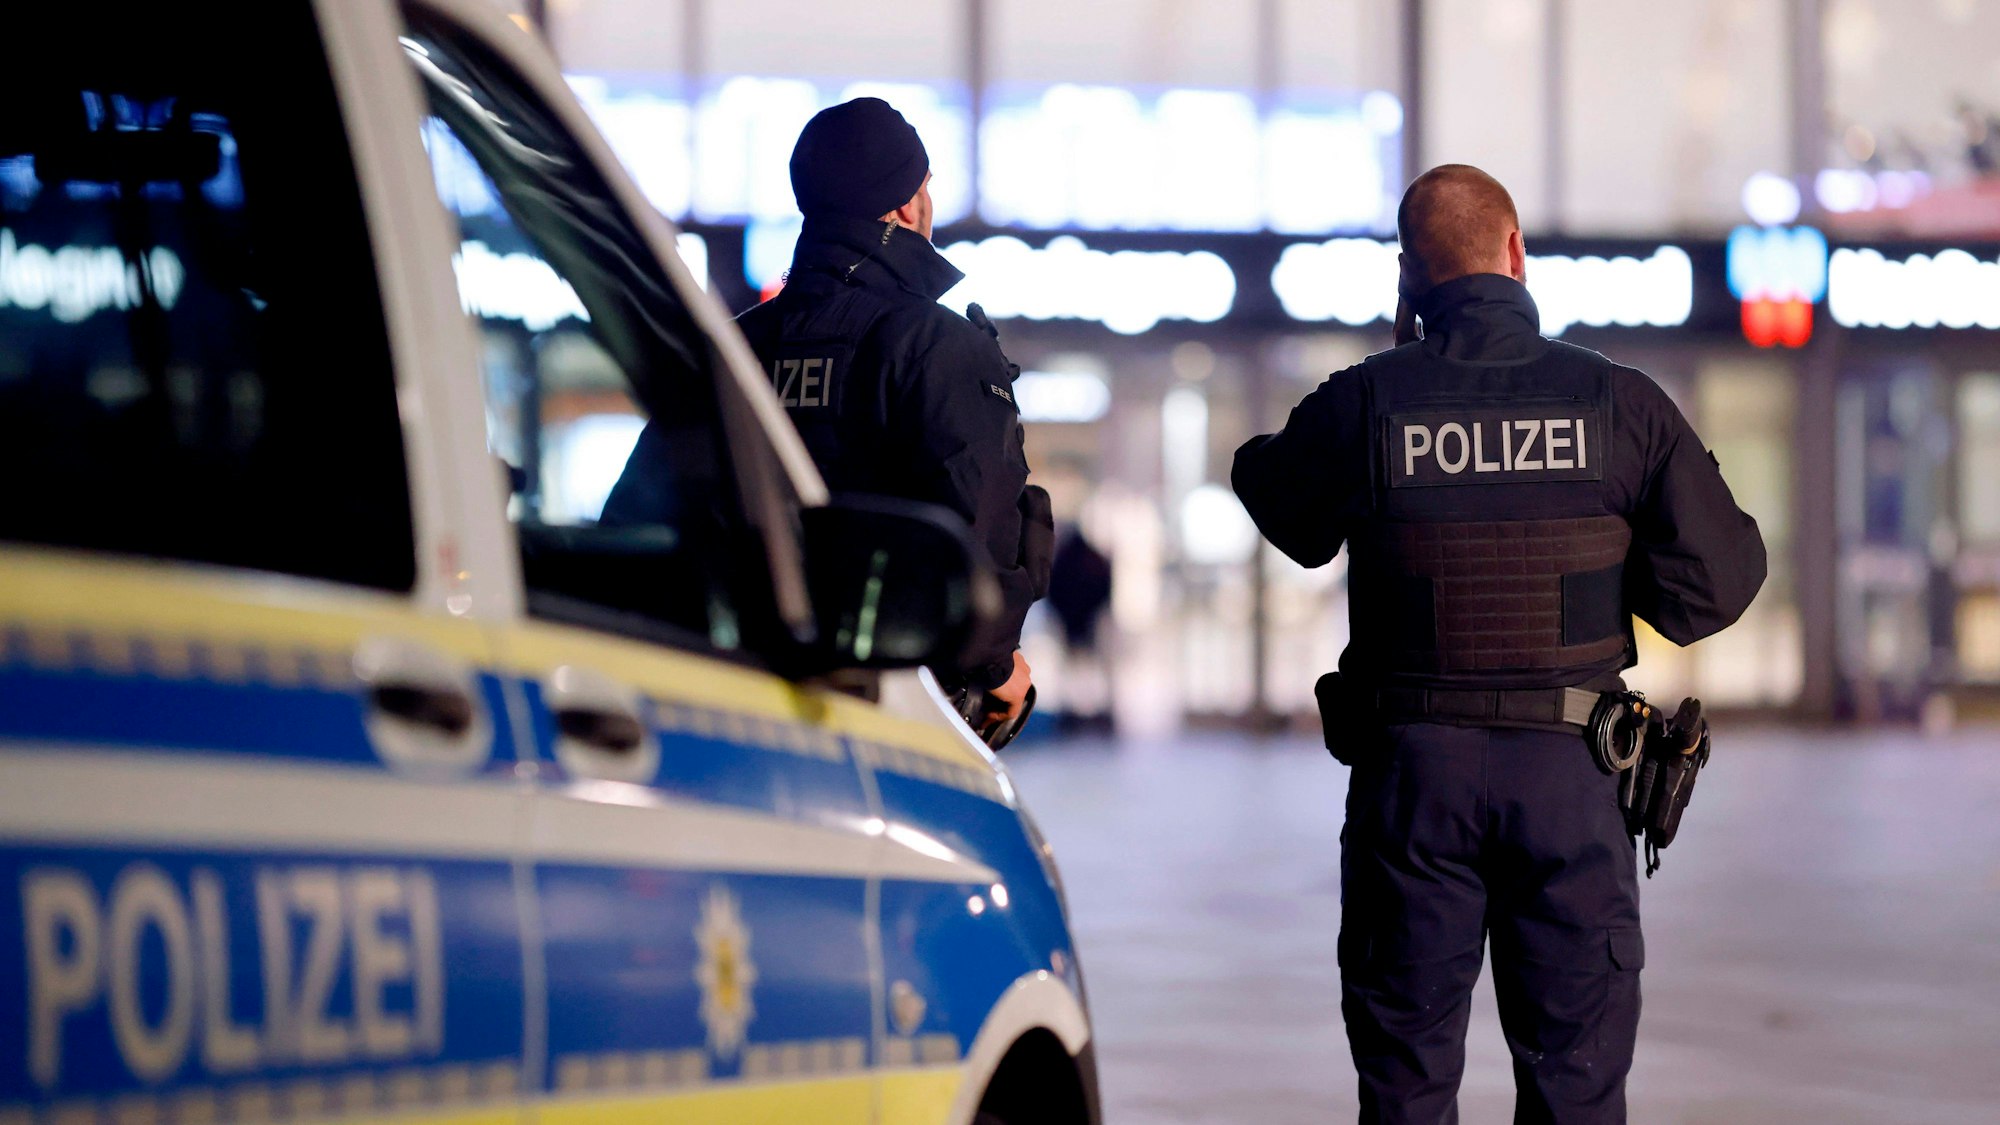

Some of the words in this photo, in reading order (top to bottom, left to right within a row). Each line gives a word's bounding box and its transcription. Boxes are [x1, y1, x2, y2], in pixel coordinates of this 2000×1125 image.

[773, 358, 834, 408] IZEI
[1404, 418, 1586, 476] POLIZEI
[20, 863, 446, 1089] POLIZEI
